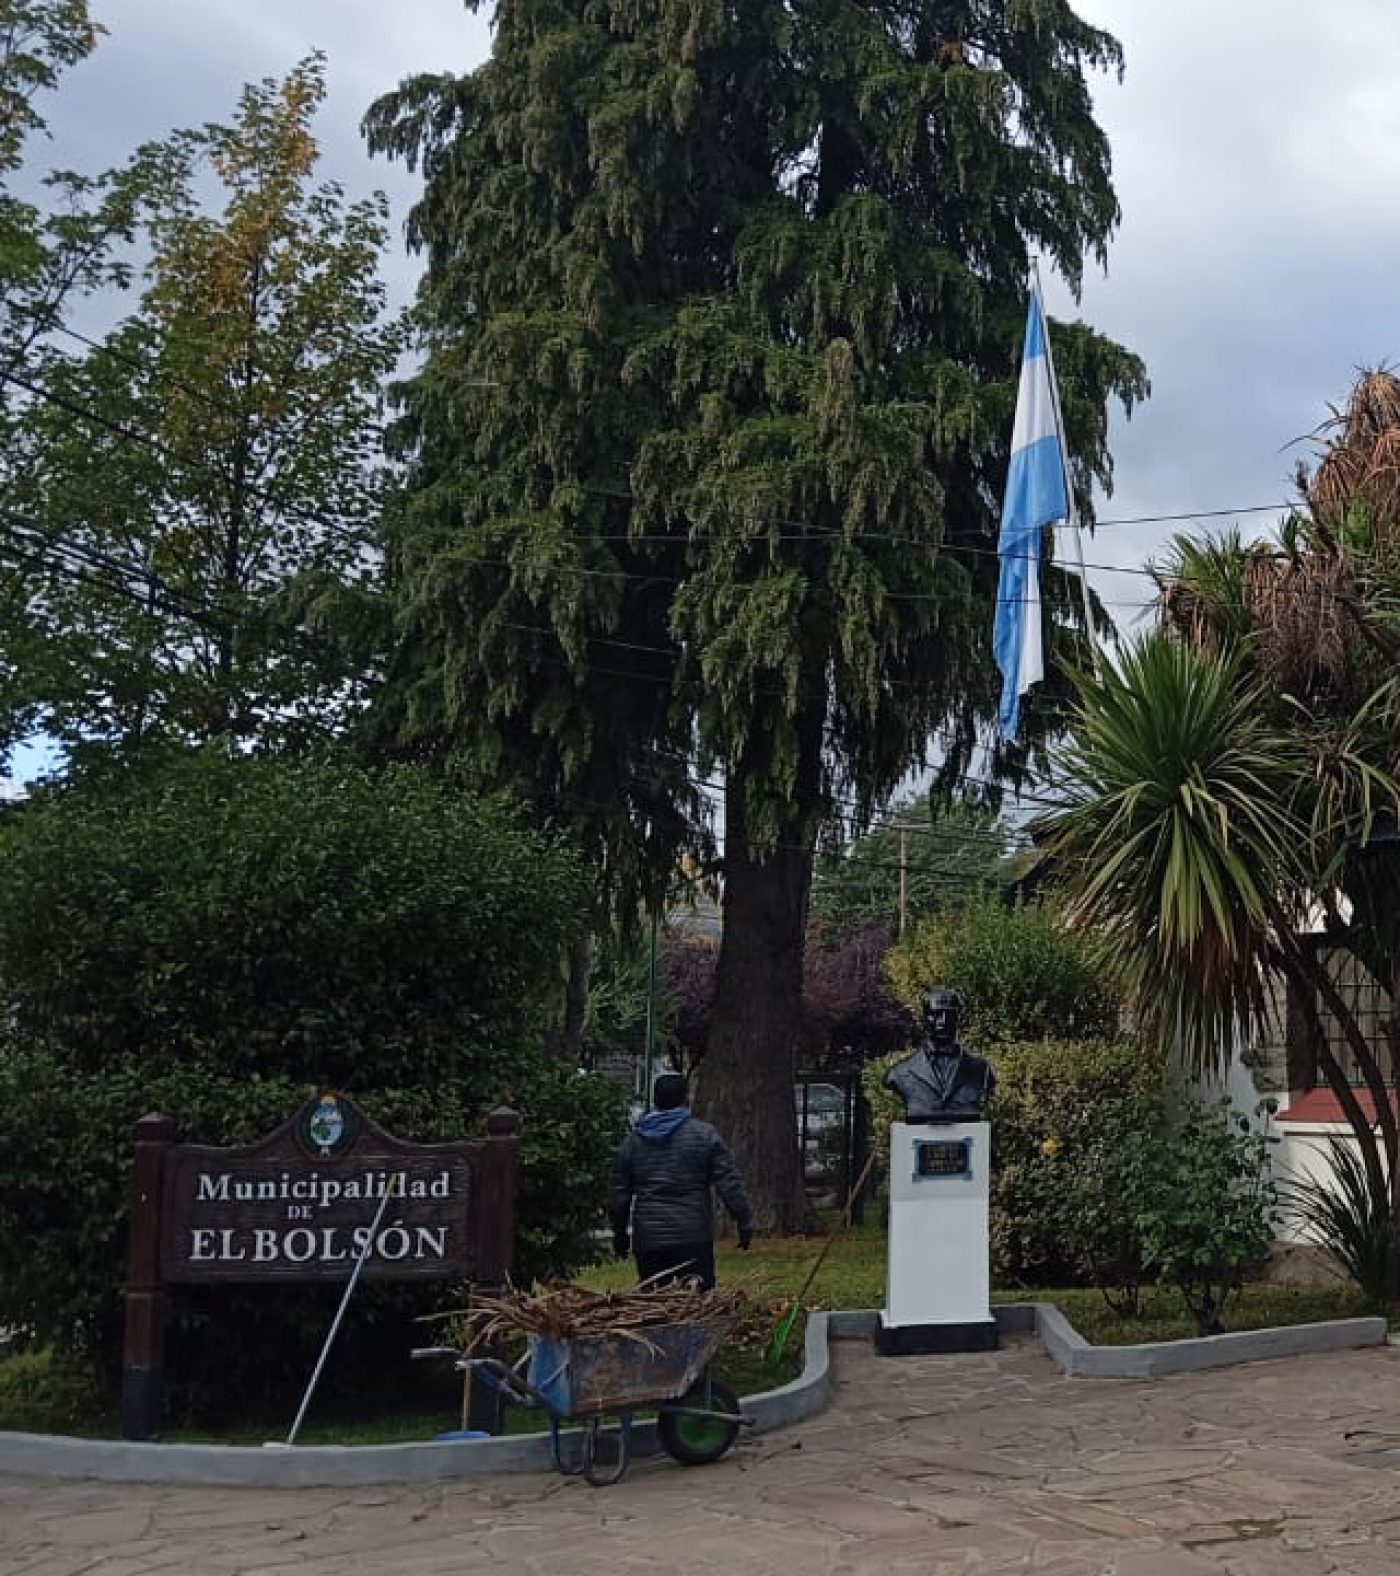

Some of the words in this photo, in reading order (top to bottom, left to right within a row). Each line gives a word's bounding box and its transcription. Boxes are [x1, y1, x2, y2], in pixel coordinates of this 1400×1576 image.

[196, 1171, 449, 1206] Municipalidad
[288, 1205, 314, 1219] DE
[188, 1229, 246, 1260] EL
[251, 1219, 449, 1261] BOLSÓN
